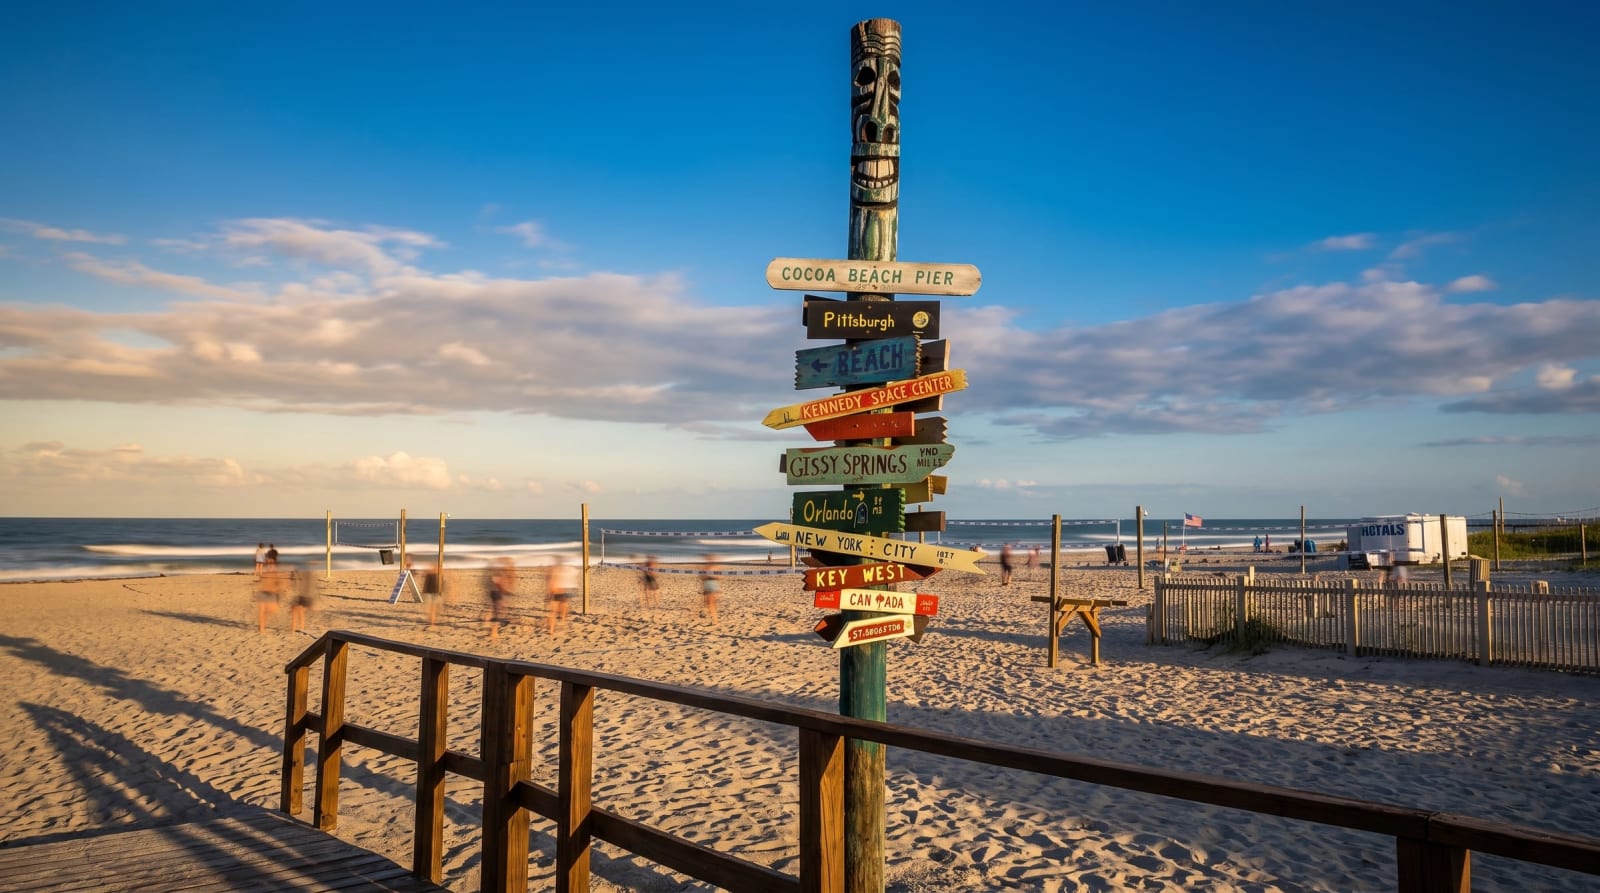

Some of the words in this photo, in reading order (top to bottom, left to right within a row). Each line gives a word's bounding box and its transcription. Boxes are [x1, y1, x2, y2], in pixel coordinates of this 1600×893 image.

[782, 266, 836, 282] COCOA
[848, 268, 902, 284] BEACH
[915, 270, 954, 286] PIER
[823, 312, 895, 332] Pittsburgh
[837, 343, 904, 376] BEACH
[802, 395, 863, 419] KENNEDY
[870, 384, 907, 405] SPACE
[911, 375, 953, 396] CENTER
[790, 455, 841, 478] GISSY
[843, 453, 907, 475] SPRINGS
[803, 499, 853, 523] Orlando
[795, 531, 827, 547] NEW
[837, 535, 863, 552] YORK
[883, 543, 917, 559] CITY
[816, 568, 848, 587] KEY
[863, 564, 905, 583] WEST
